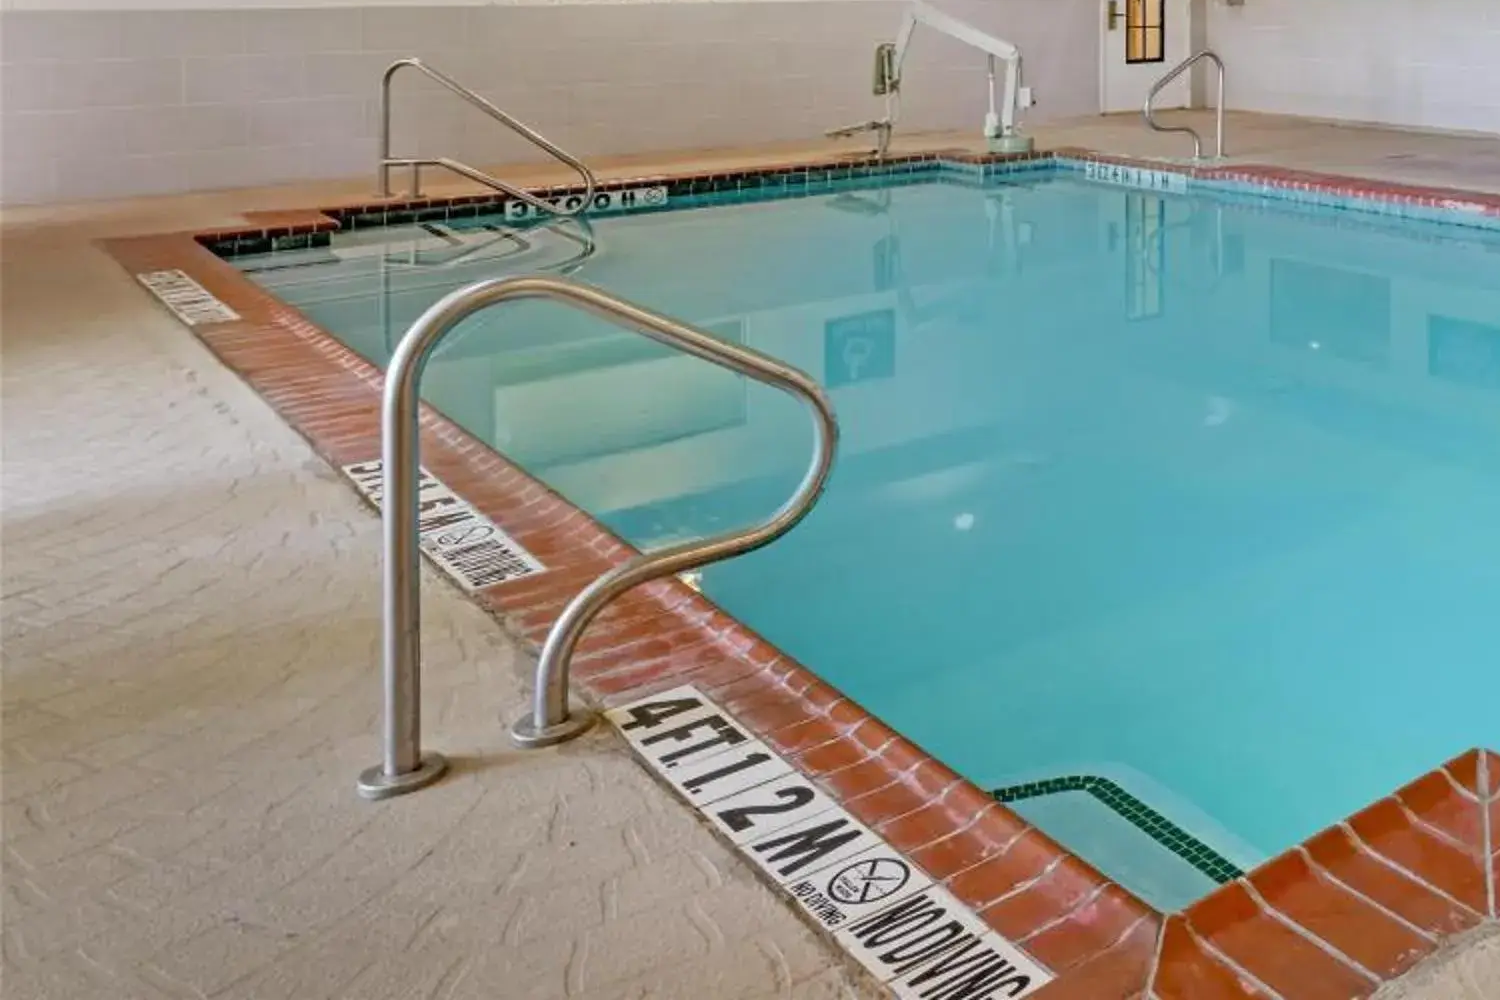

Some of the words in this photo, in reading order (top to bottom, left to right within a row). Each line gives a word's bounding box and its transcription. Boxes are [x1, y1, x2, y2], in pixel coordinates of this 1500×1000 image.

[621, 698, 704, 731] 4
[752, 818, 863, 877] M
[791, 881, 816, 897] NO
[803, 892, 847, 925] DIVING
[848, 894, 947, 949] NO
